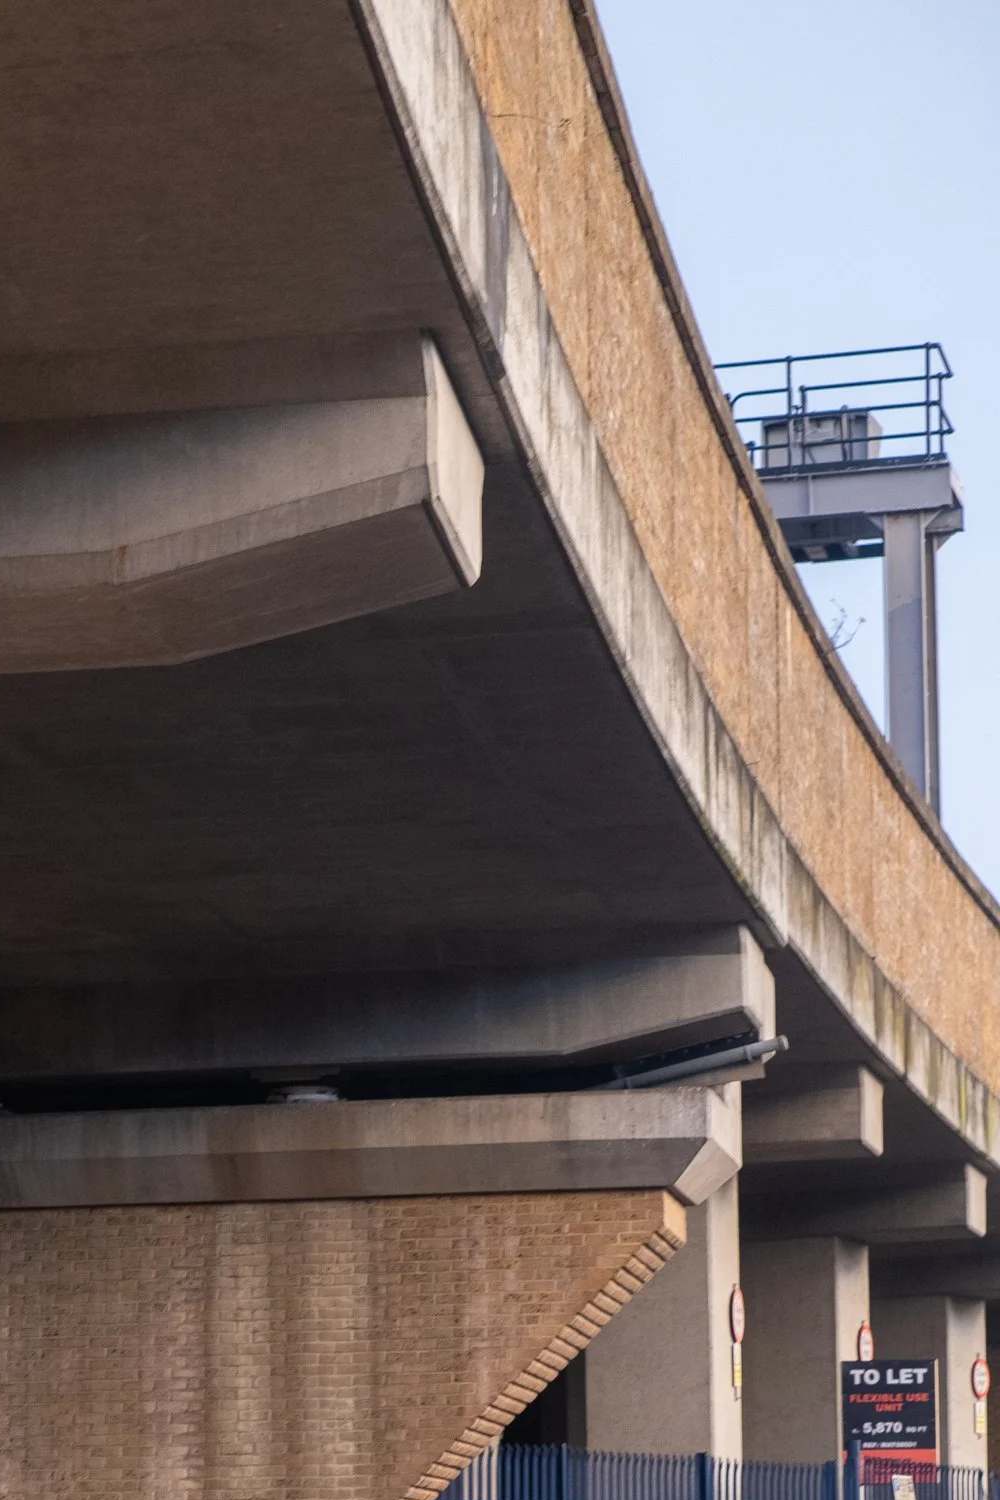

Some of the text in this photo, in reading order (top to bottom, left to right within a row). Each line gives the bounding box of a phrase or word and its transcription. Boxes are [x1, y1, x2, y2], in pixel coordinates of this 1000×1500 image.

[849, 1368, 928, 1385] TO LET
[849, 1392, 929, 1403] FLEXIBLE USE
[875, 1403, 903, 1412] UNIT
[862, 1421, 903, 1436] 5,870
